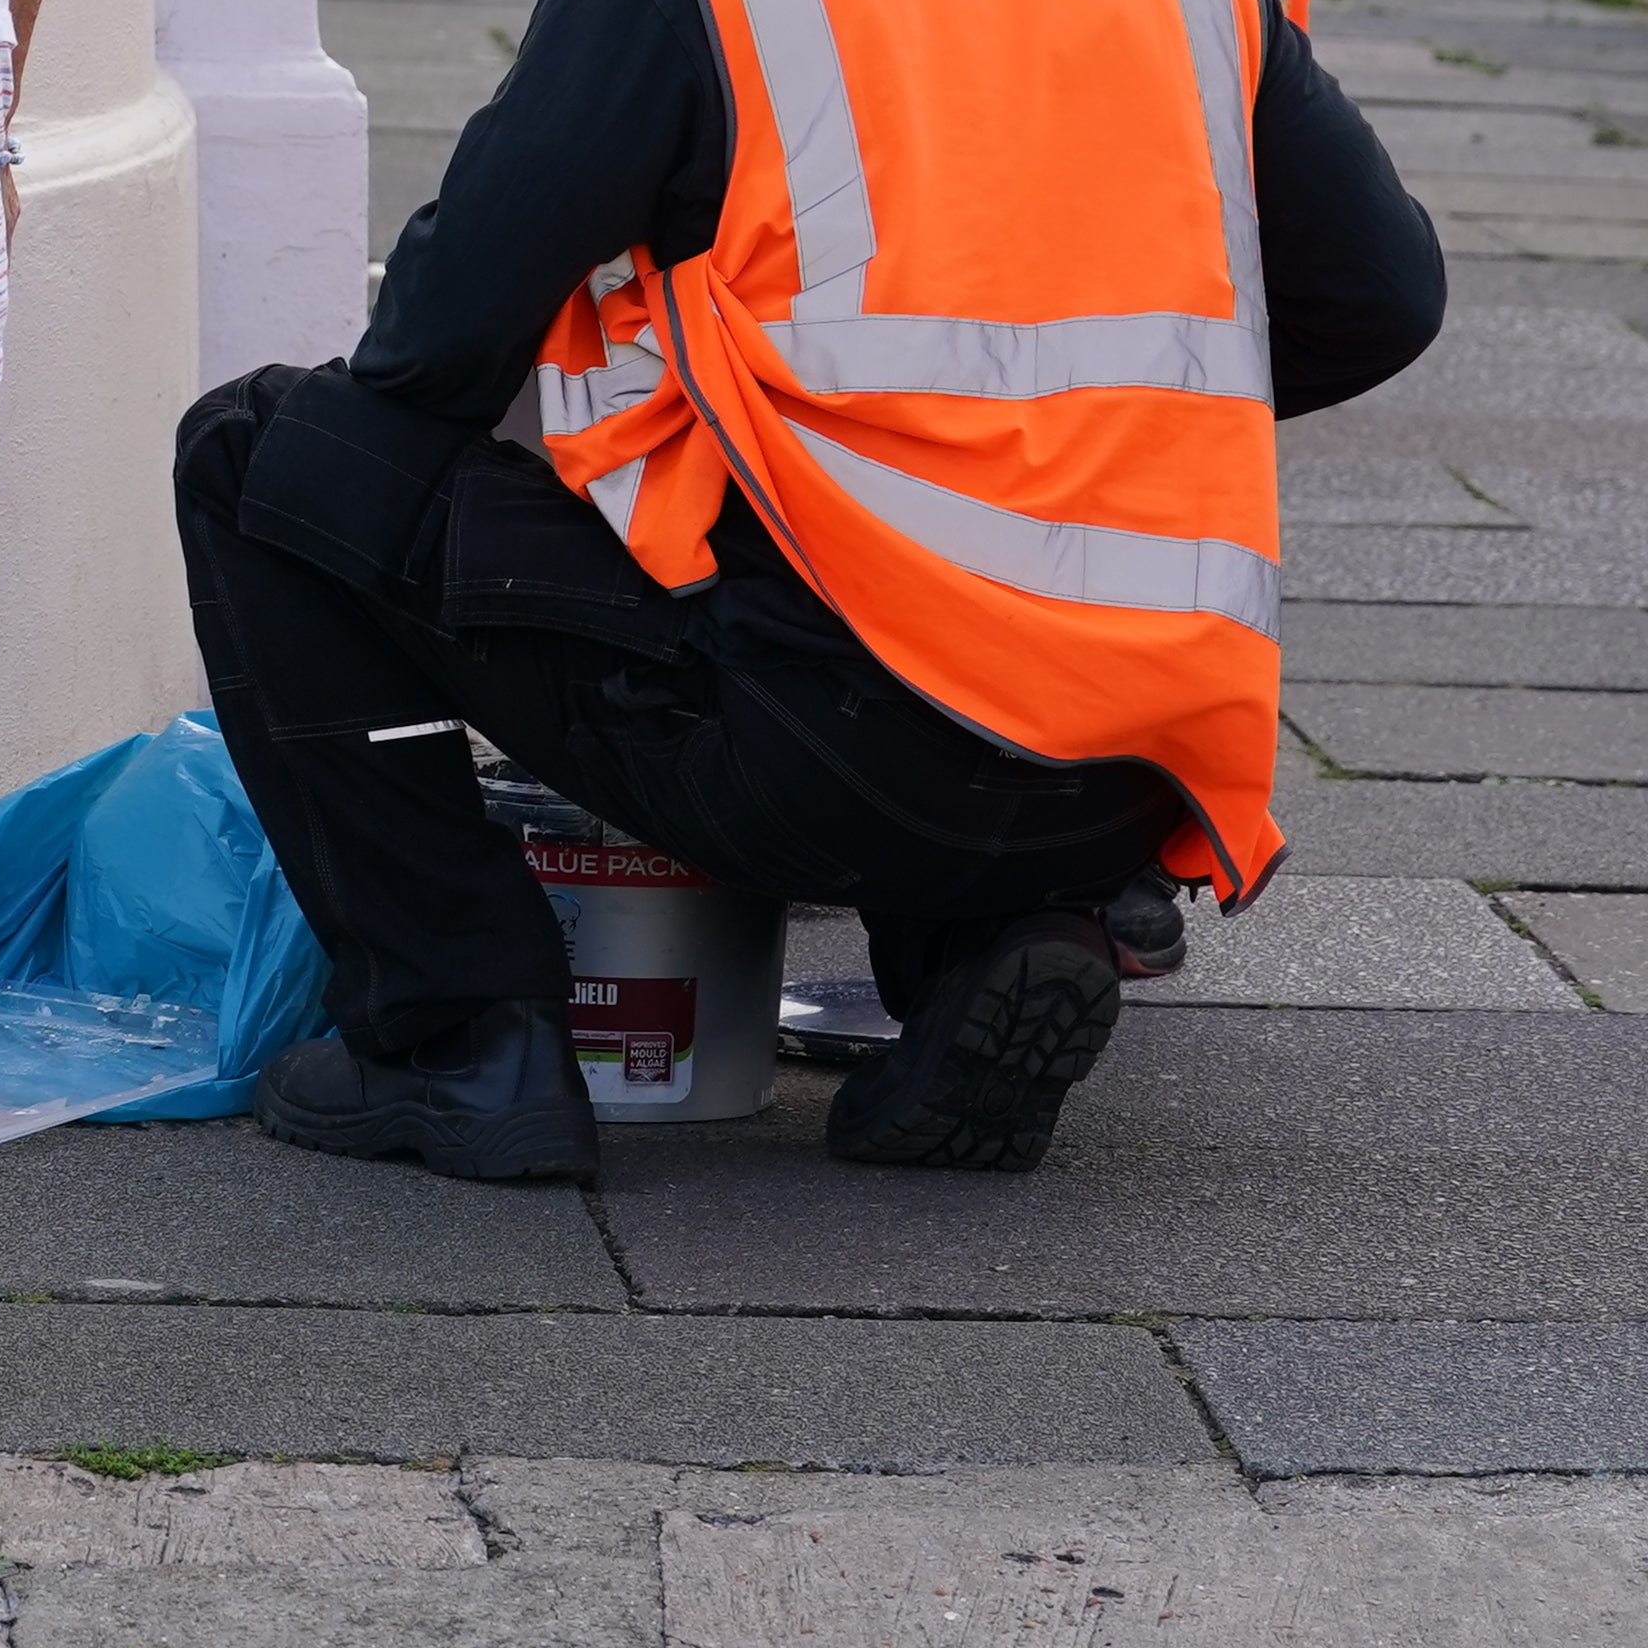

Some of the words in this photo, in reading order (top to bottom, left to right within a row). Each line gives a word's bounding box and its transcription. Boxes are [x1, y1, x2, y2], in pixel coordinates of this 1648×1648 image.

[525, 849, 599, 875] ALUE
[607, 854, 689, 877] PACK
[630, 1049, 667, 1059] MOULD
[636, 1058, 667, 1068] ALGAE
